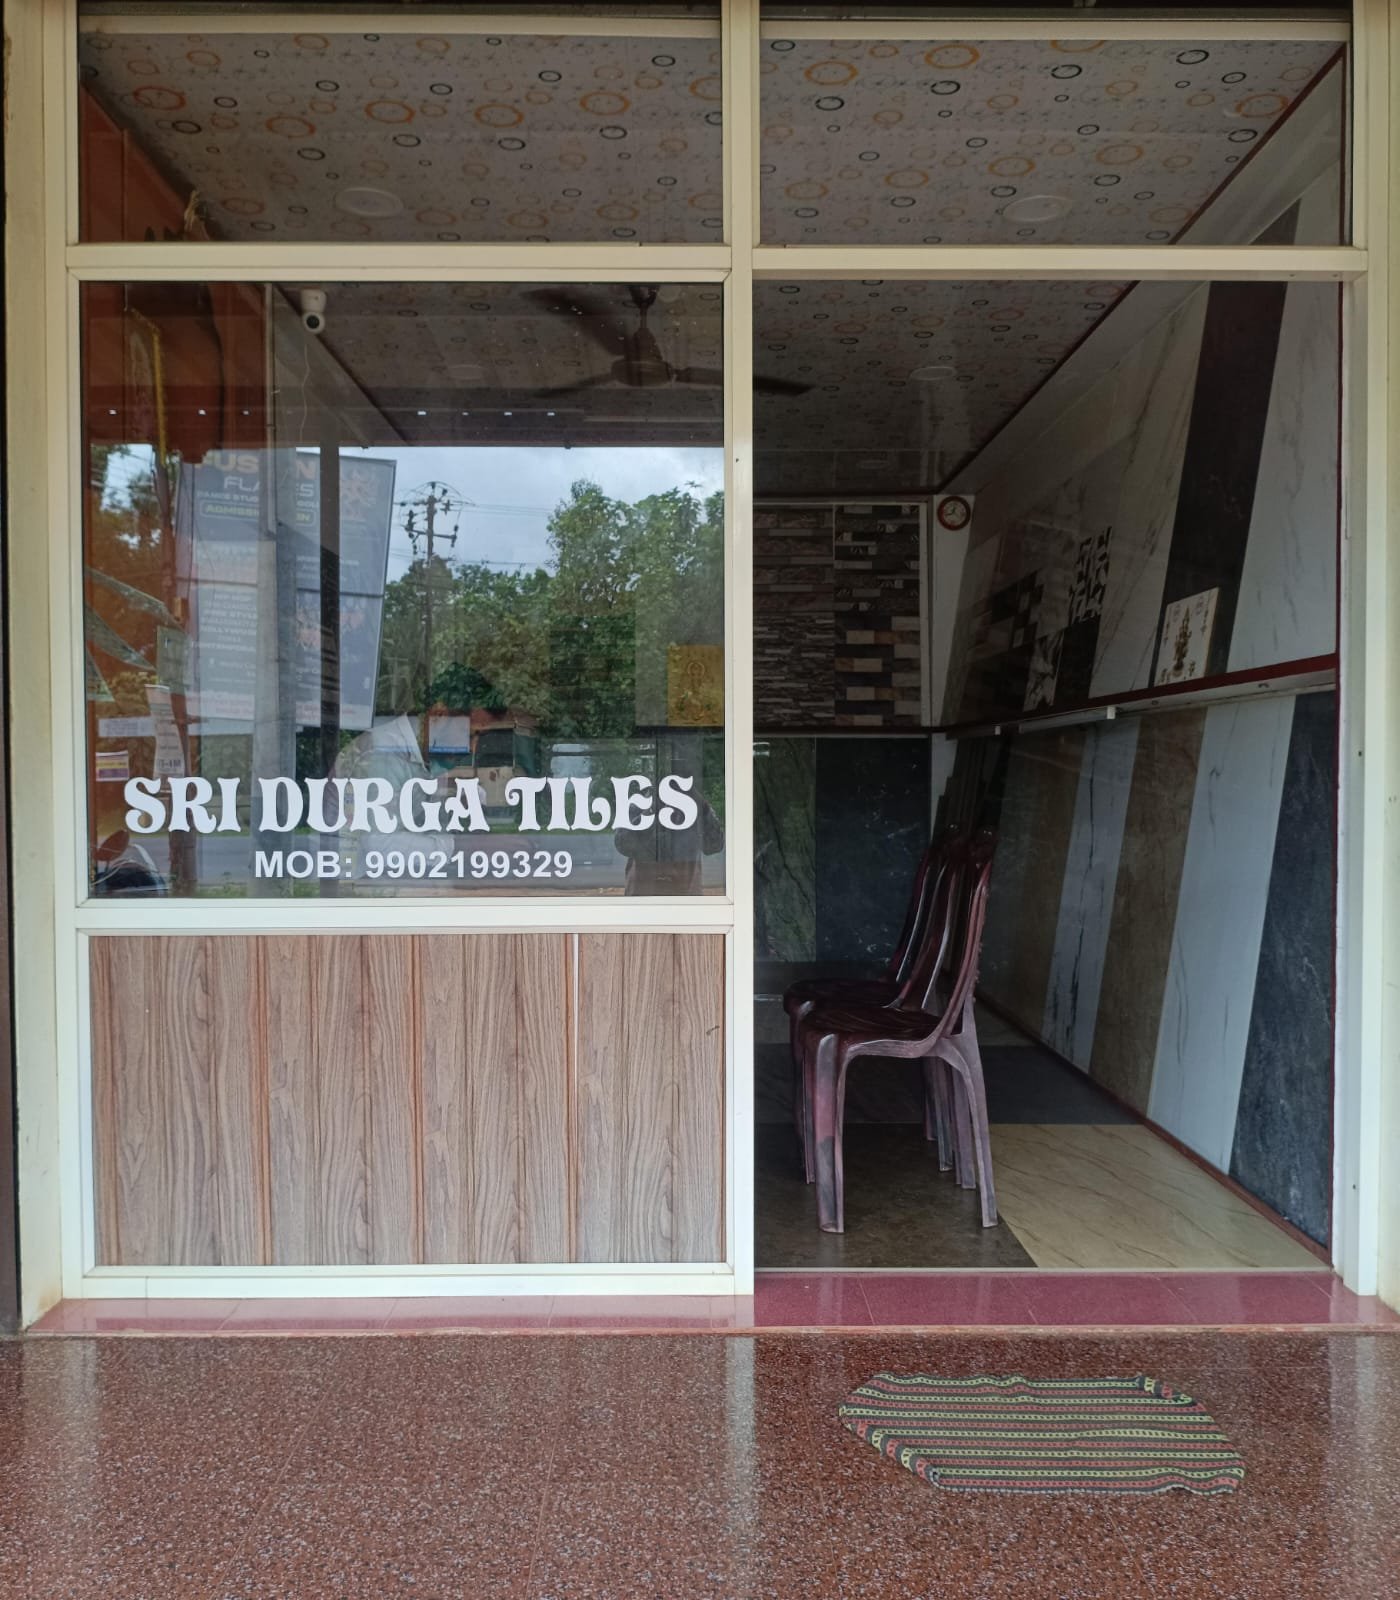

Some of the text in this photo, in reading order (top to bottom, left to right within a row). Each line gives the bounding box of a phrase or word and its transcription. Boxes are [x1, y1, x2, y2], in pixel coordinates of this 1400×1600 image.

[123, 775, 698, 834] SRI DURGA TILES
[255, 850, 573, 879] MOB: 9902199329
